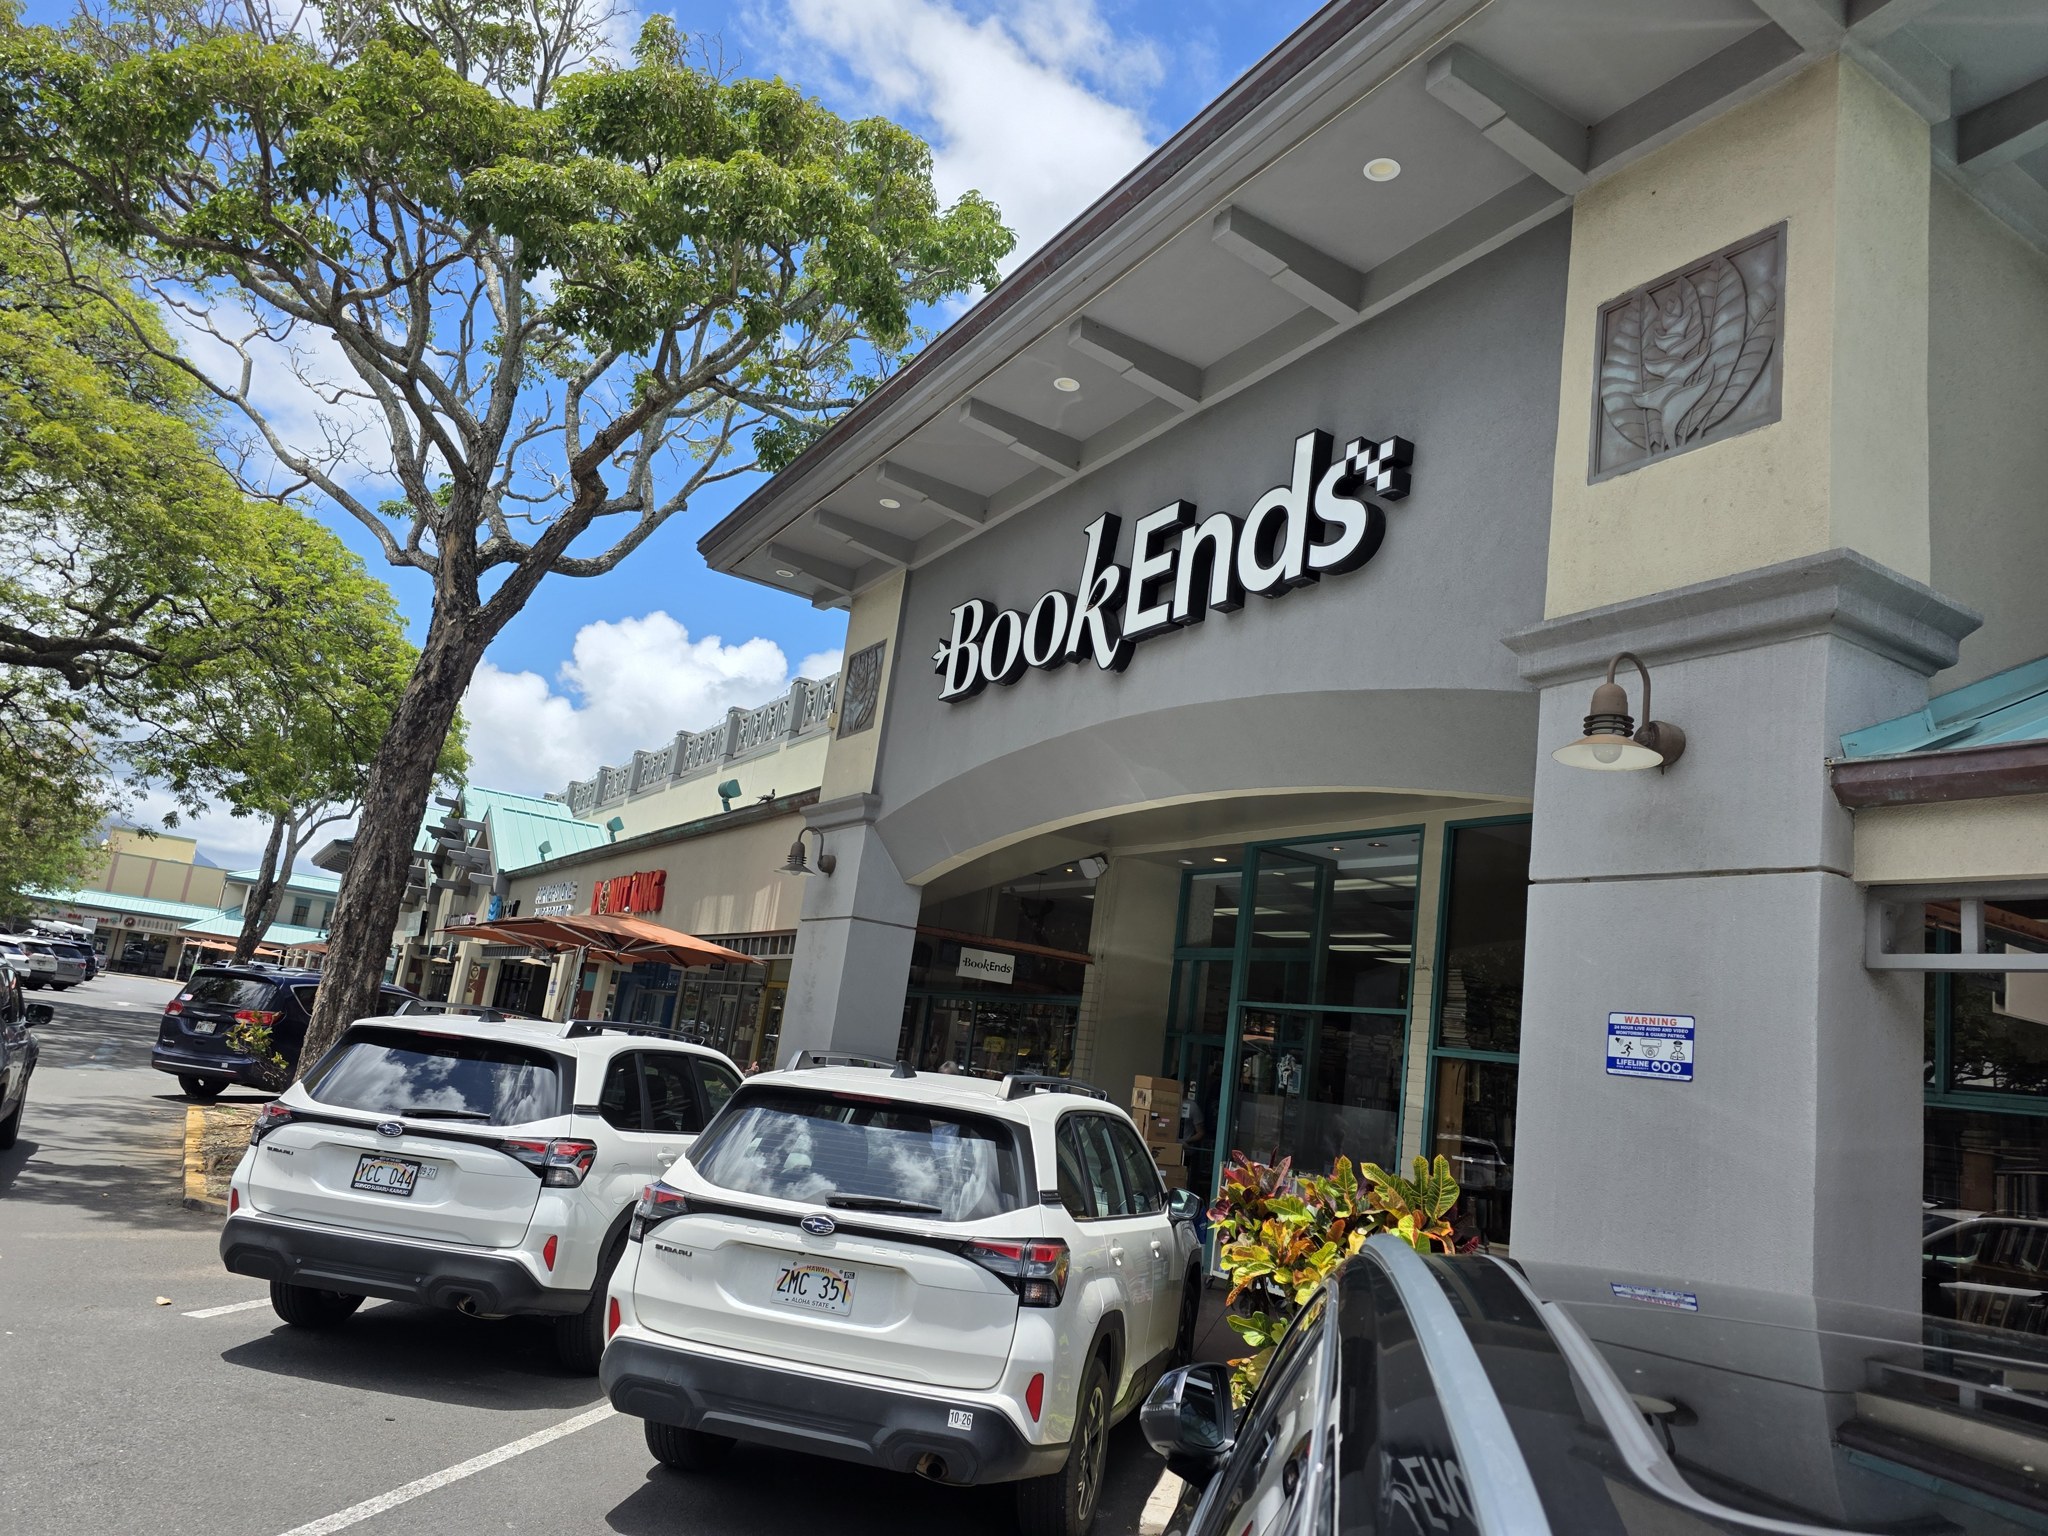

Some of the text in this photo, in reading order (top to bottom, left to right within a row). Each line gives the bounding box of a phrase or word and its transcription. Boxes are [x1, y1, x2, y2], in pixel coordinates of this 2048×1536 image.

[932, 428, 1414, 703] BookEnds
[591, 876, 632, 915] DONUT
[630, 869, 667, 913] KING
[963, 957, 1012, 974] BookEnds
[1624, 1016, 1677, 1026] WARNING
[1616, 1059, 1649, 1067] LIFELINE
[267, 1146, 293, 1156] SUBARU
[359, 1163, 414, 1188] YCC 044
[655, 1243, 692, 1257] SUBARU
[806, 1265, 830, 1273] HAWAII
[777, 1268, 849, 1303] ZMC 351
[791, 1297, 830, 1308] ALOHA STATE
[950, 1411, 972, 1426] 10 26
